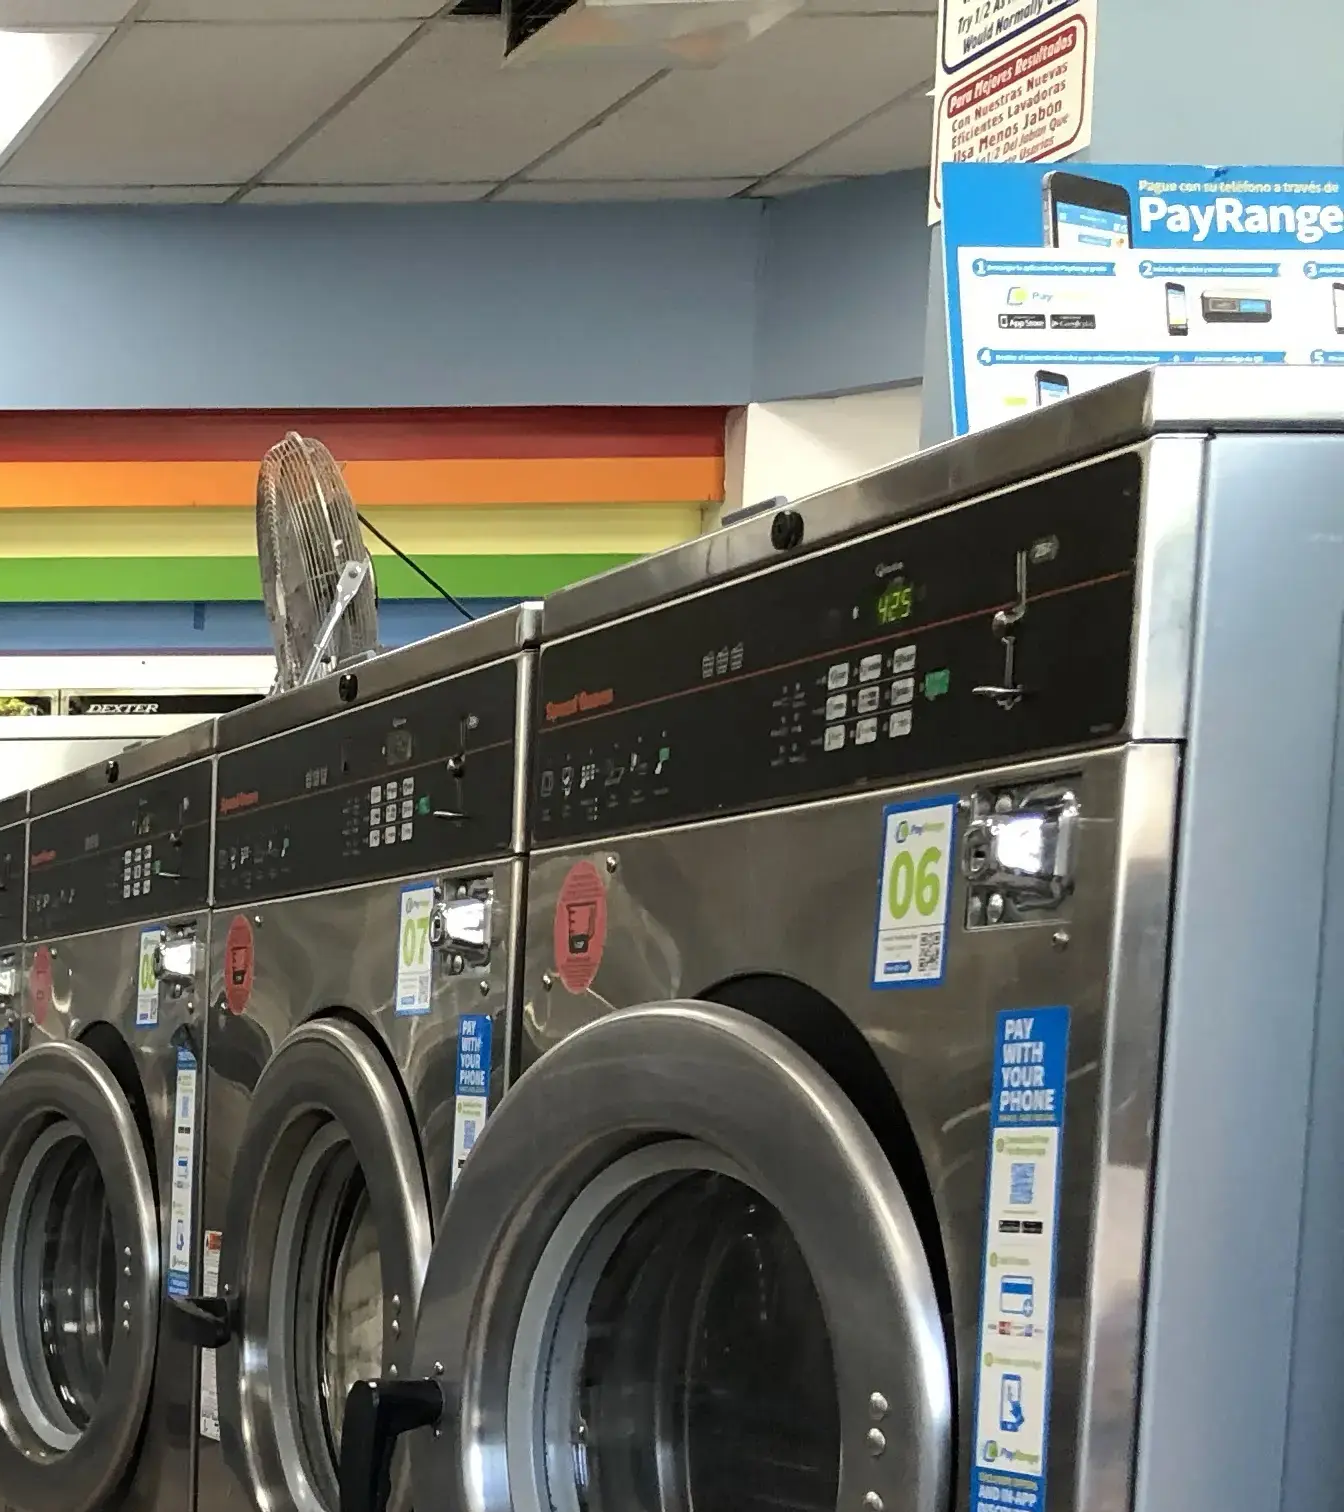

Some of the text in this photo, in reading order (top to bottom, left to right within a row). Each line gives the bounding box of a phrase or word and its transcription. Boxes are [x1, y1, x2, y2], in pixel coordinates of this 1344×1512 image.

[963, 26, 994, 55] Would
[952, 61, 1068, 133] Con Nuestras Nuevas
[951, 79, 1066, 150] Eficientes Lavadoras
[979, 121, 1019, 153] Menos
[1138, 180, 1177, 195] Pague
[1179, 182, 1201, 193] con
[1204, 182, 1218, 193] su
[1273, 183, 1282, 193] a
[1324, 181, 1340, 193] de
[1139, 196, 1344, 244] PayRange
[86, 702, 160, 714] DEXTER
[888, 846, 942, 920] 06
[402, 917, 430, 967] 07
[462, 1019, 477, 1036] PAY
[1004, 1017, 1035, 1041] PAY
[461, 1037, 481, 1053] WITH
[1002, 1041, 1044, 1064] WITH
[460, 1053, 481, 1069] YOUR
[459, 1069, 486, 1086] PHONE
[1001, 1065, 1046, 1088] YOUR
[999, 1088, 1056, 1112] PHONE
